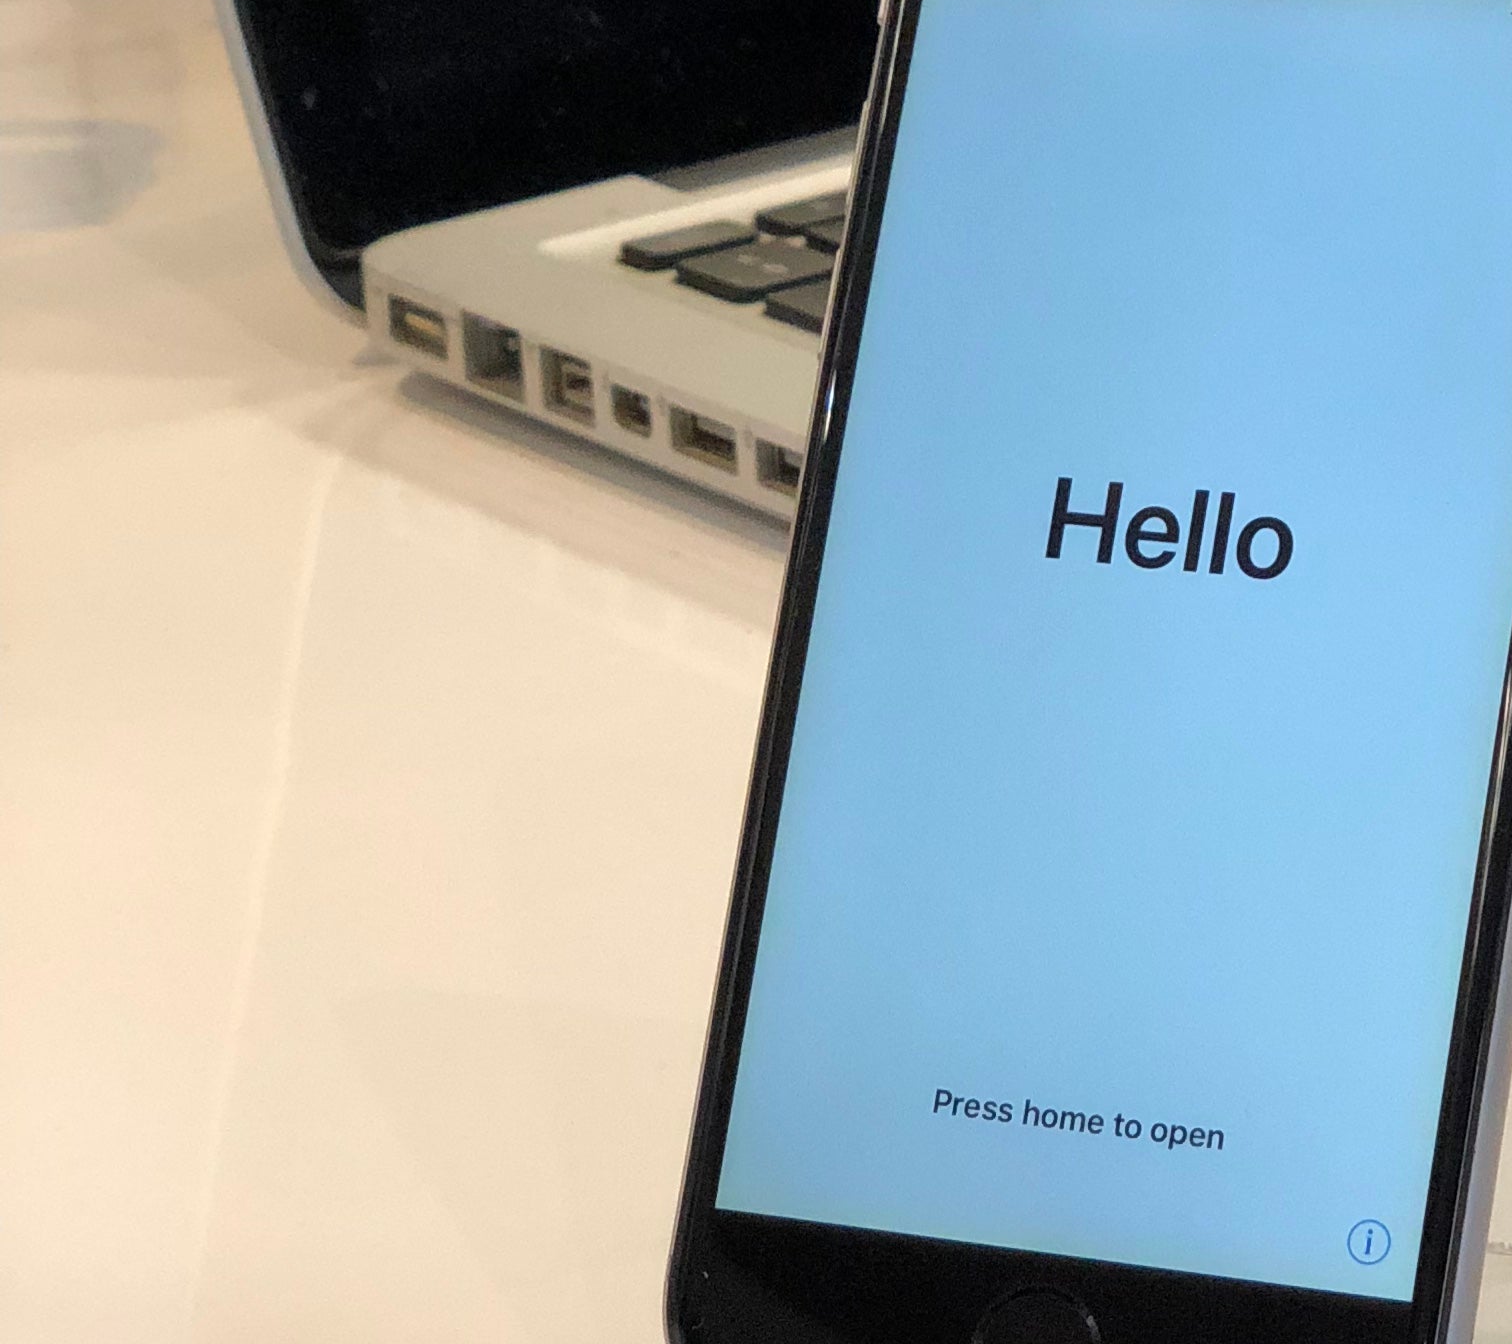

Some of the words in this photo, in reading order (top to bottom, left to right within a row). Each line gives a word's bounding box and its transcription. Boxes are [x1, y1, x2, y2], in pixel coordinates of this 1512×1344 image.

[1044, 476, 1294, 580] Hello
[933, 1089, 1014, 1124] Press
[1022, 1099, 1105, 1135] home
[1113, 1112, 1143, 1140] to
[1149, 1123, 1226, 1151] open
